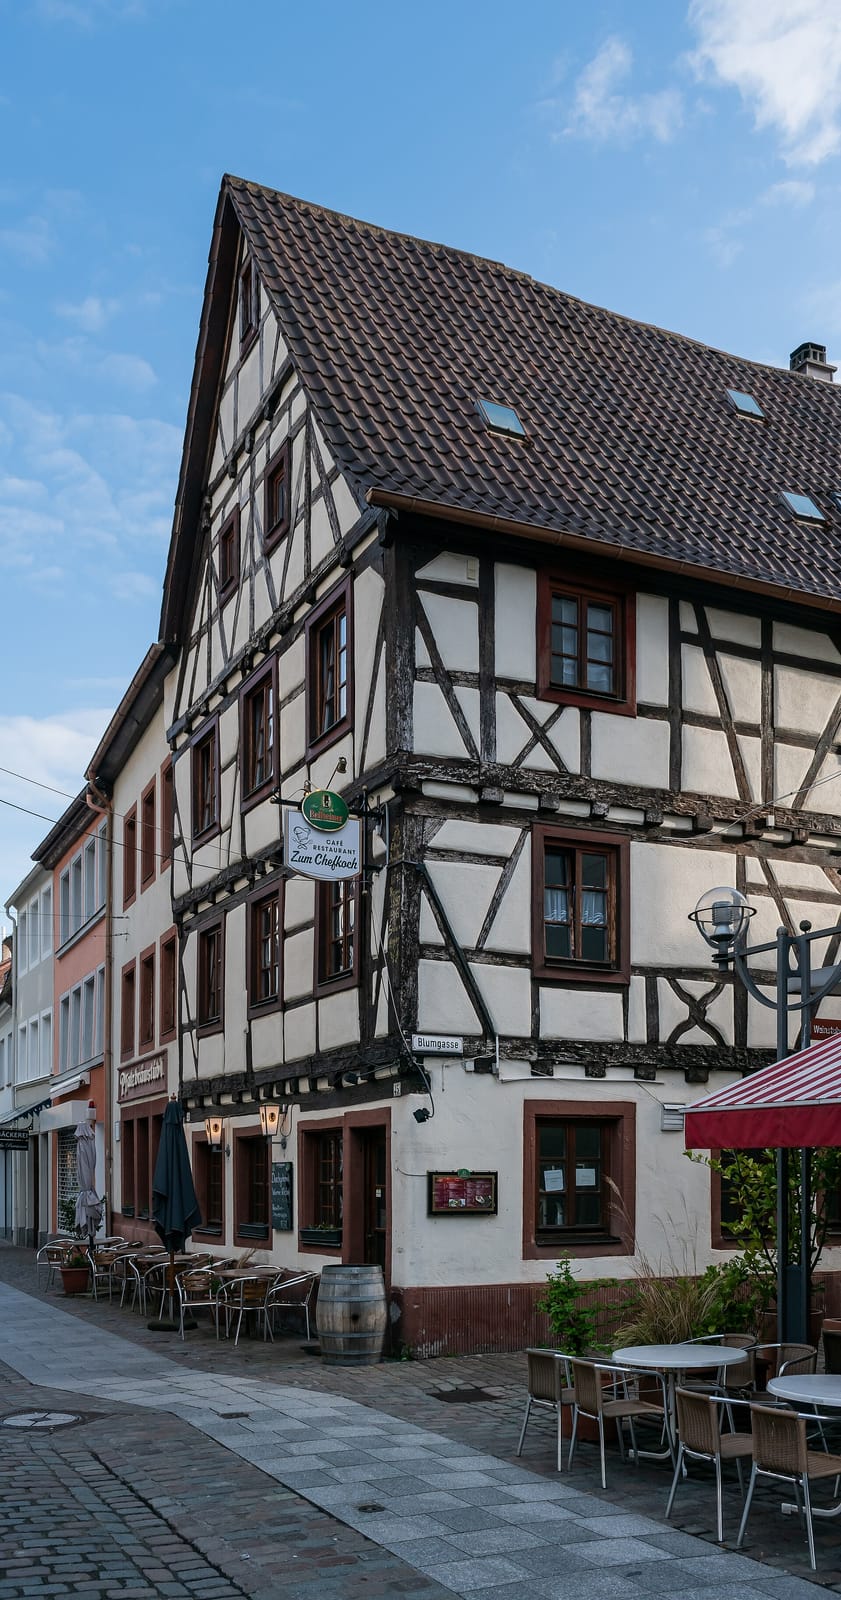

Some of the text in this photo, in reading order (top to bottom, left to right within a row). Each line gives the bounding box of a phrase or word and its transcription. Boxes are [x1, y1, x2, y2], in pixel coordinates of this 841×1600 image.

[313, 845, 356, 855] RESTAURANT
[291, 851, 357, 870] Zum Chefkoch
[417, 1037, 459, 1050] Blumgasse
